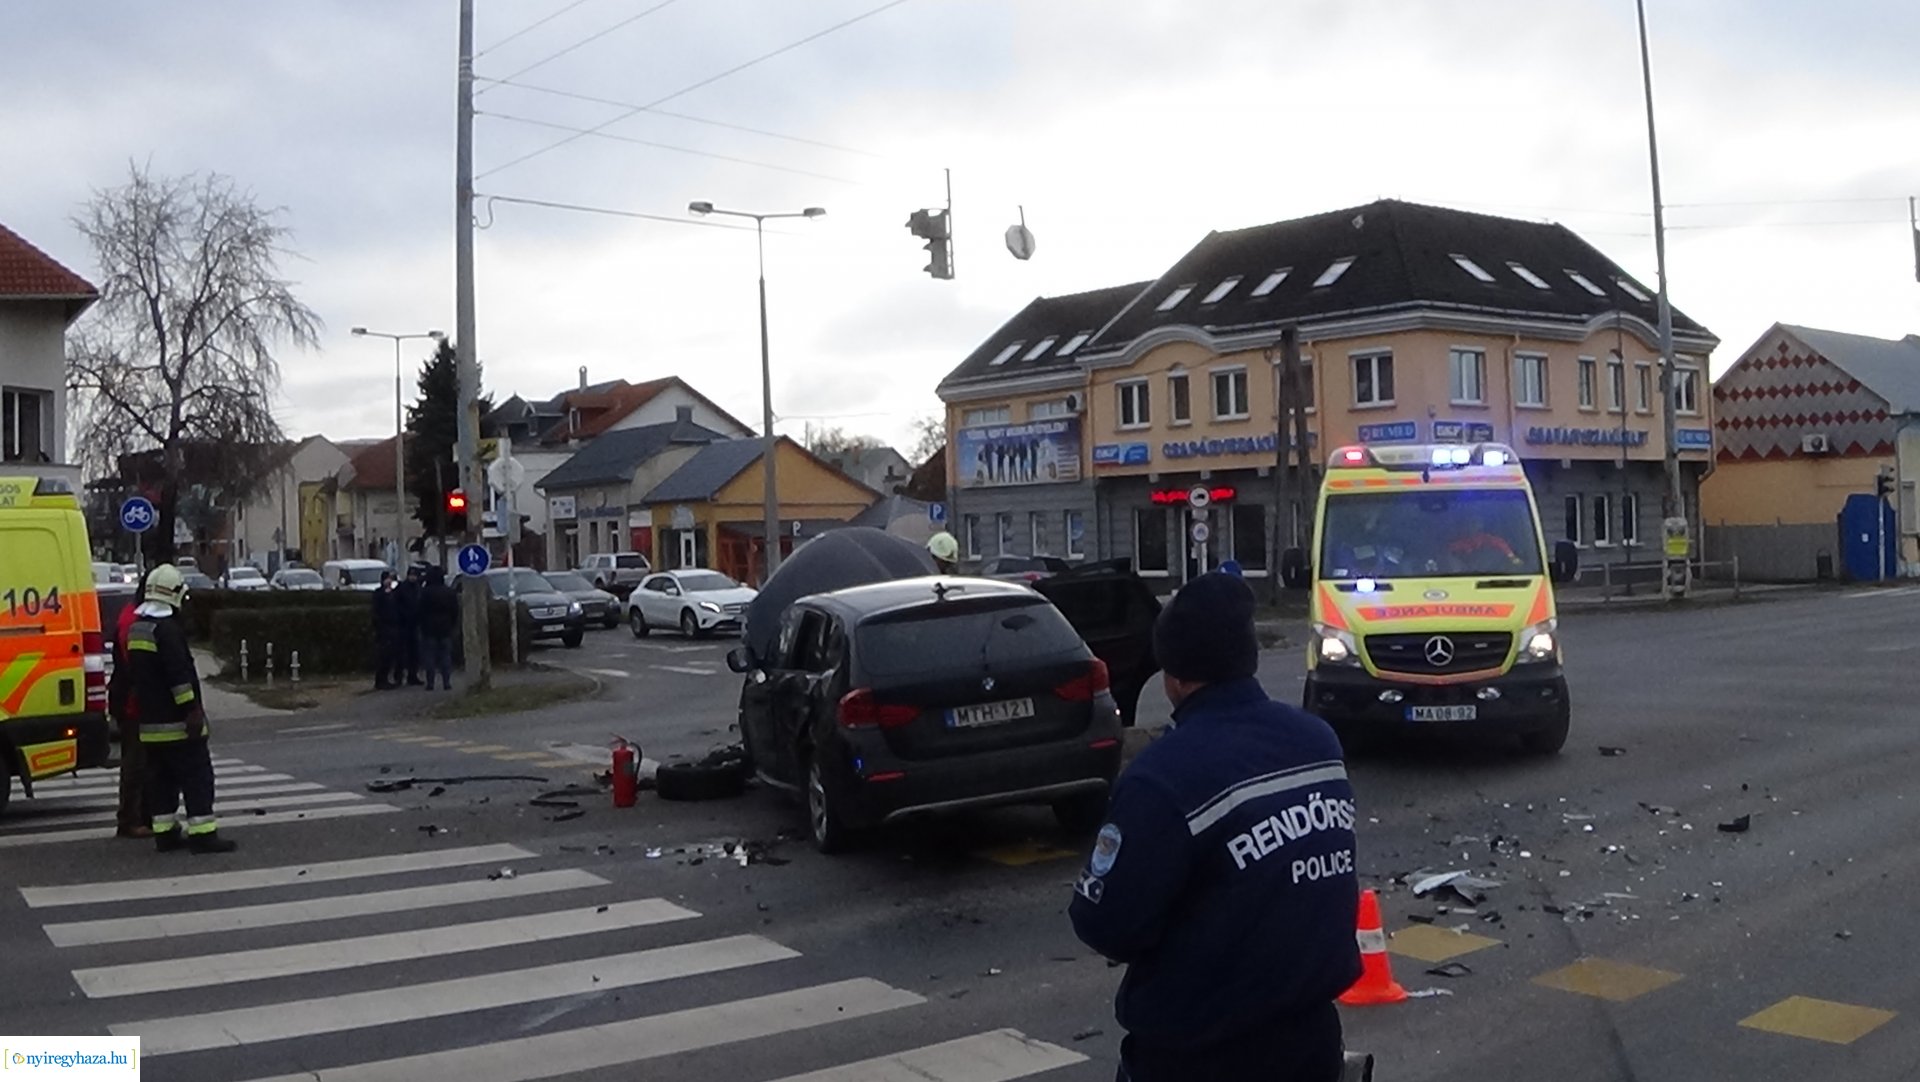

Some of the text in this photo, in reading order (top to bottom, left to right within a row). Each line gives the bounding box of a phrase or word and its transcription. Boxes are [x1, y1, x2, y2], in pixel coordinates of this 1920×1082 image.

[4, 586, 62, 617] 104
[957, 700, 1030, 723] MTH-121
[1227, 792, 1356, 870] RENDŐRS
[1292, 849, 1353, 884] POLICE
